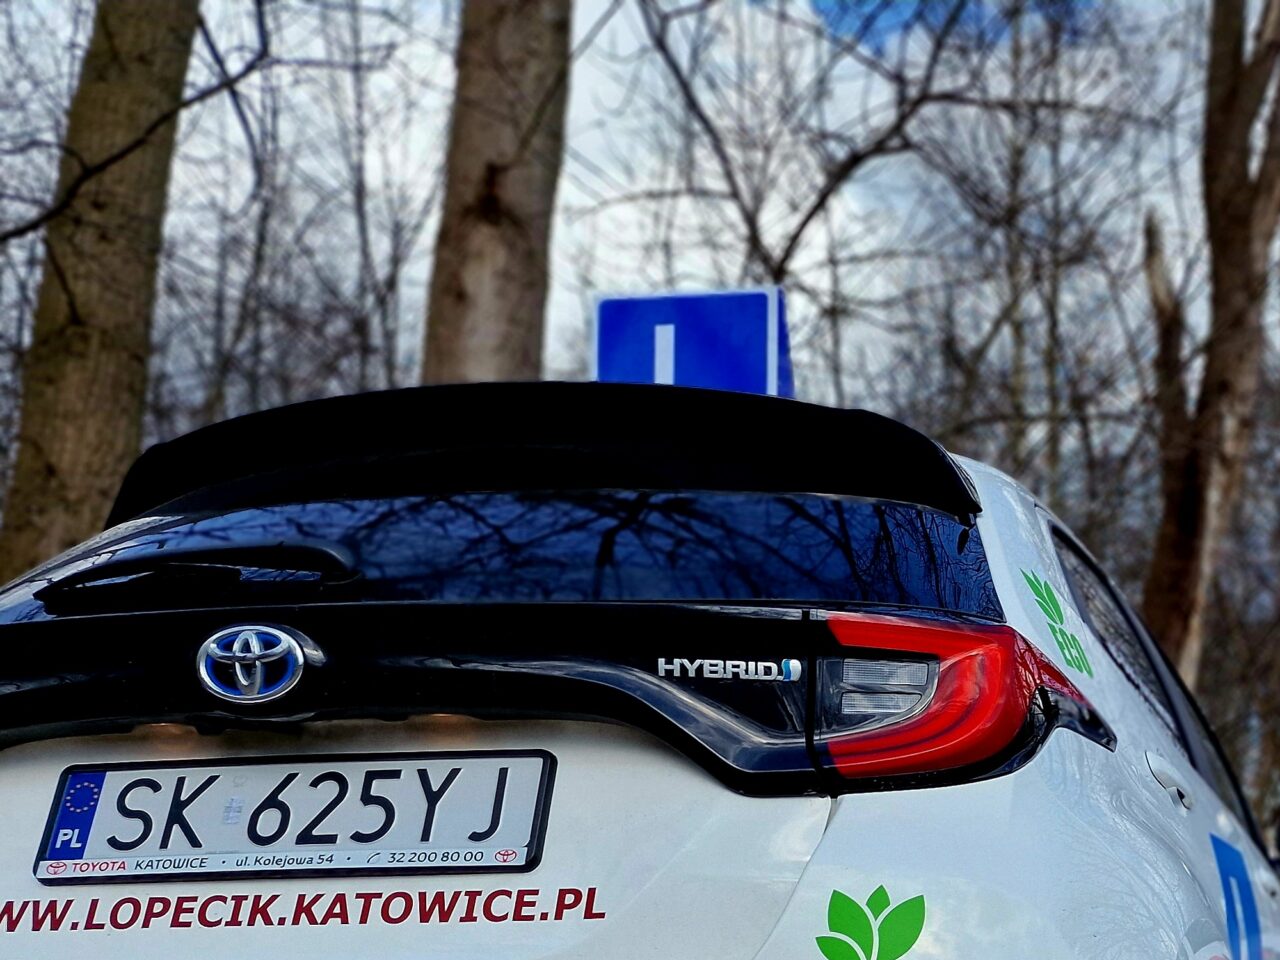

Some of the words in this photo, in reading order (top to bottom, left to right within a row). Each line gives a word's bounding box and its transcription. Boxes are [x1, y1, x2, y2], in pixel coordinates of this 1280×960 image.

[1047, 622, 1094, 679] ECO
[658, 658, 779, 681] HYBRID
[107, 774, 220, 851] SK
[247, 767, 509, 847] 625YJ
[55, 828, 82, 849] PL
[72, 860, 127, 873] TOYOTA
[134, 857, 208, 871] KATOWICE
[235, 855, 250, 867] ul.
[254, 854, 314, 867] Kolejowa
[317, 853, 335, 865] 54
